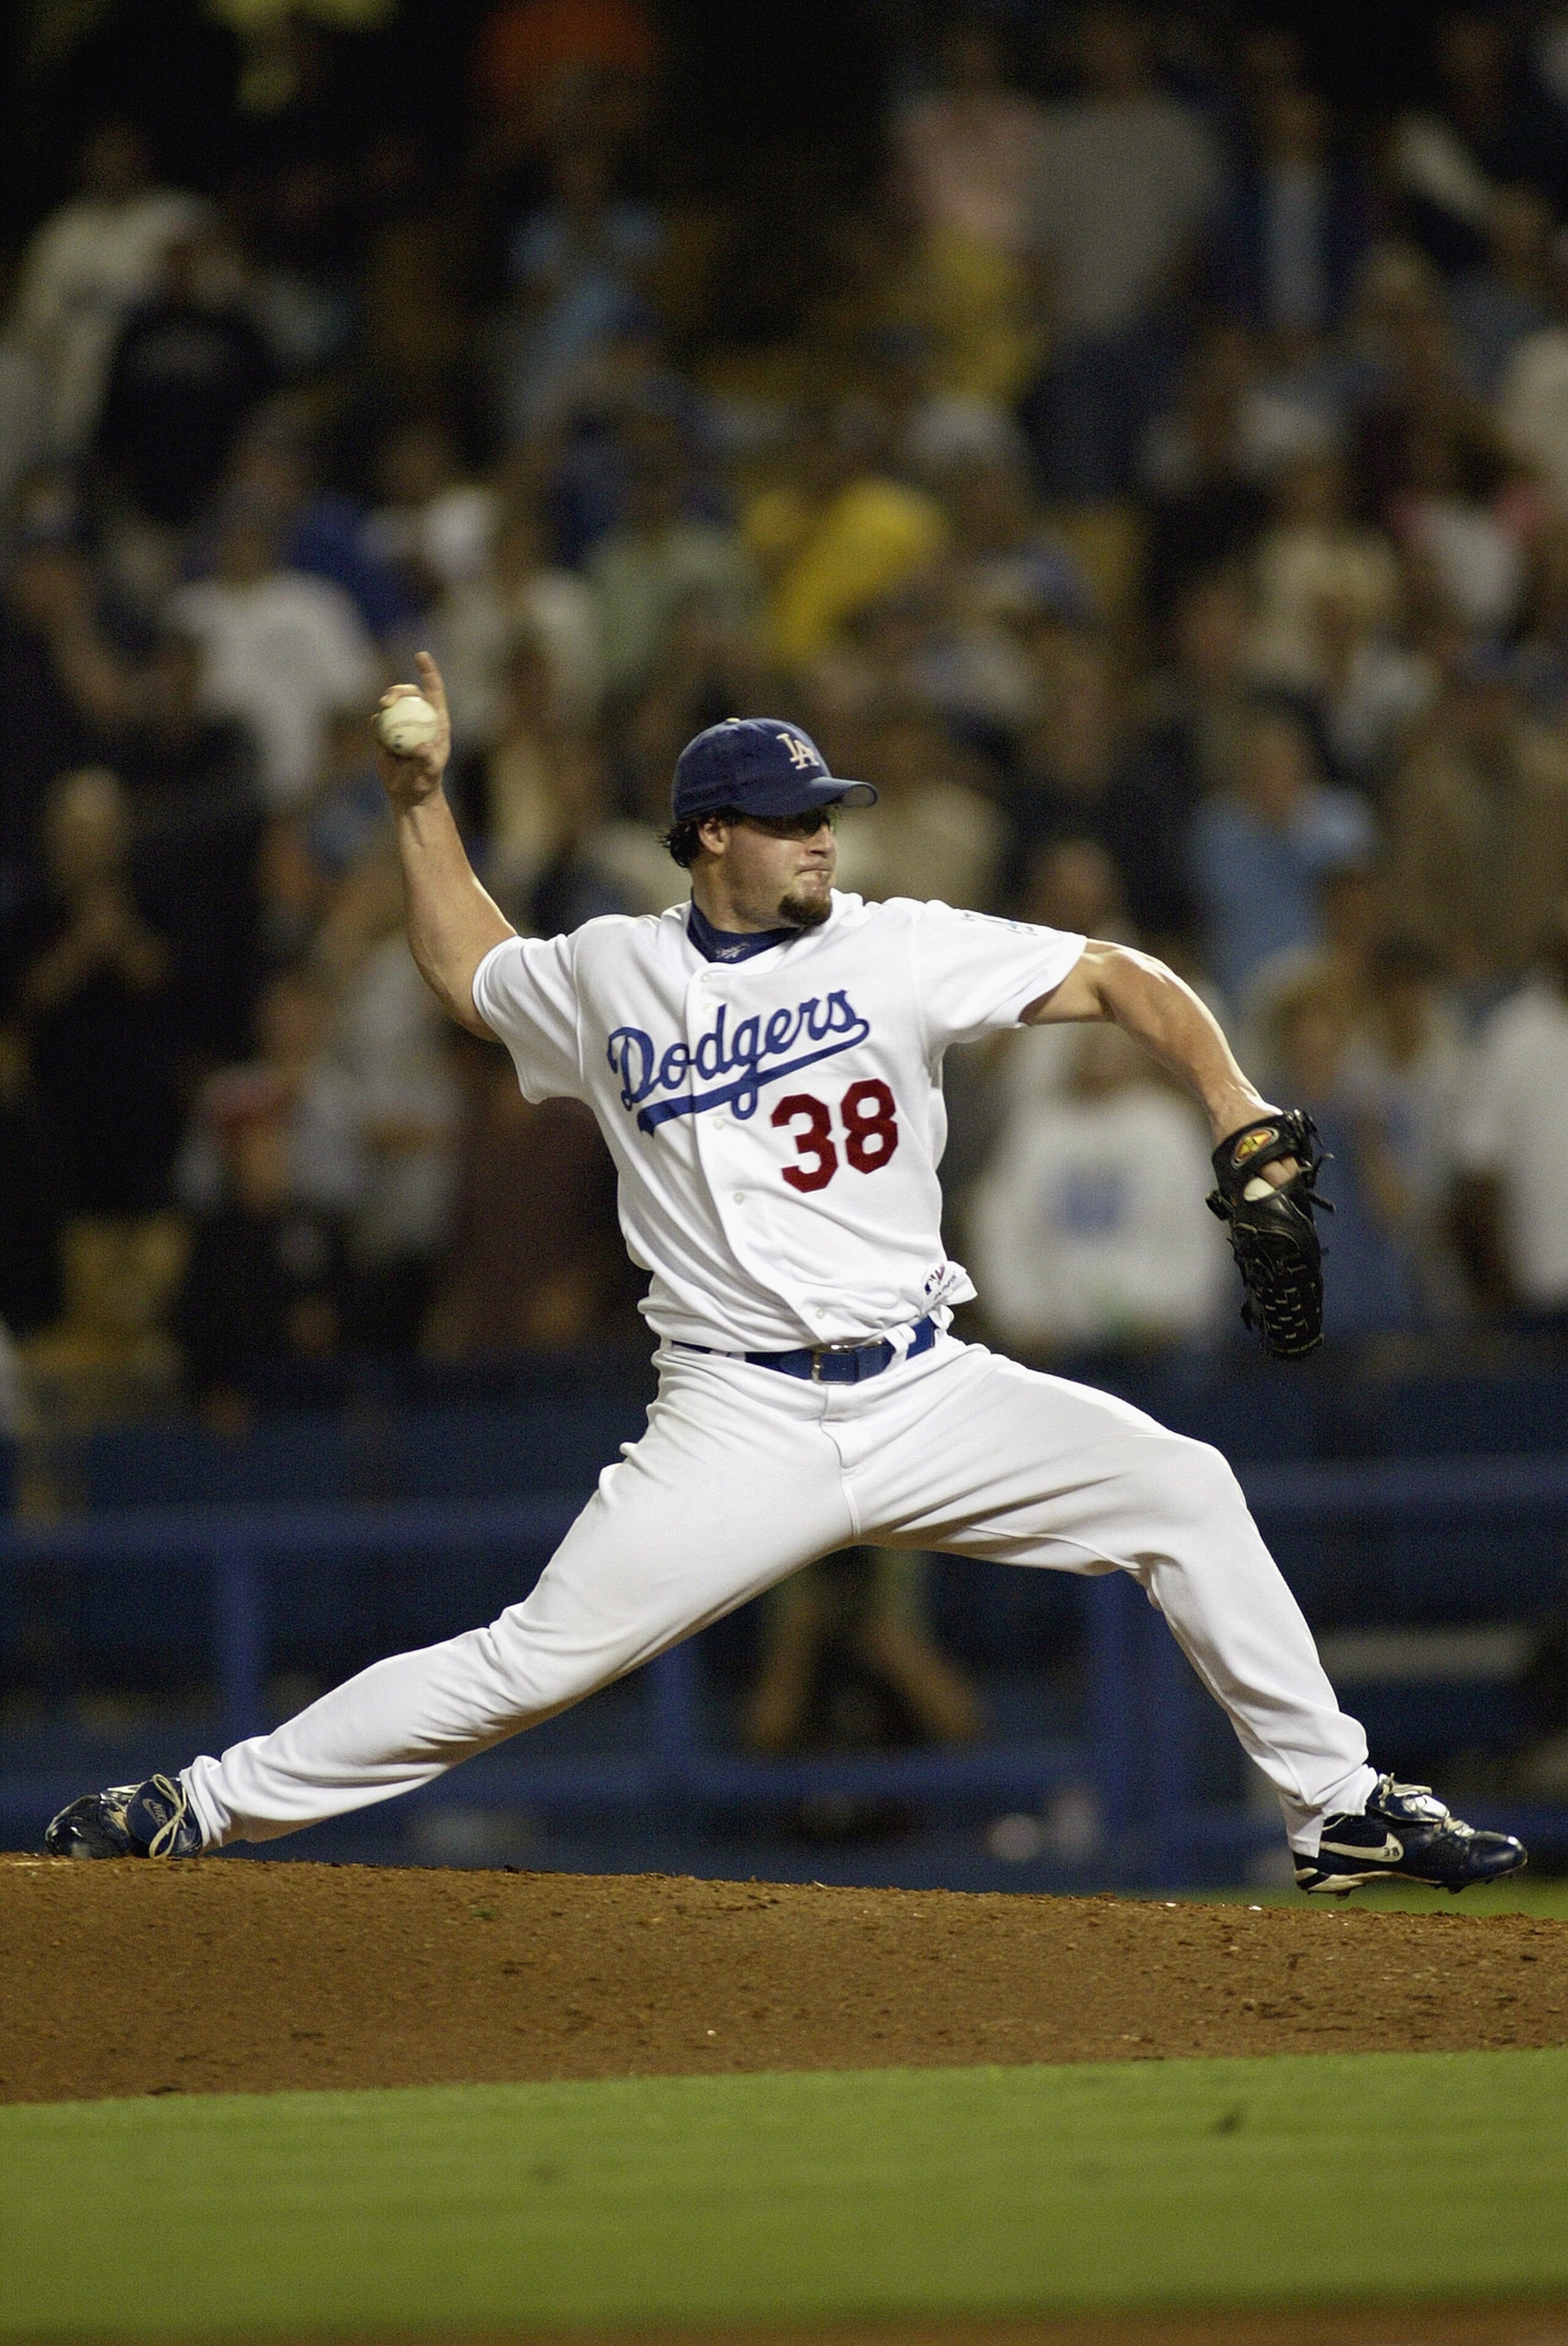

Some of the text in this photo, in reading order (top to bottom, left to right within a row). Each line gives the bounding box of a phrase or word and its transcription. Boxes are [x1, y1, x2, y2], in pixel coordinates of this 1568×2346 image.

[775, 733, 820, 770] LA
[608, 989, 865, 1120] Dodgers
[771, 1078, 899, 1193] 38
[1384, 1847, 1400, 1856] 38
